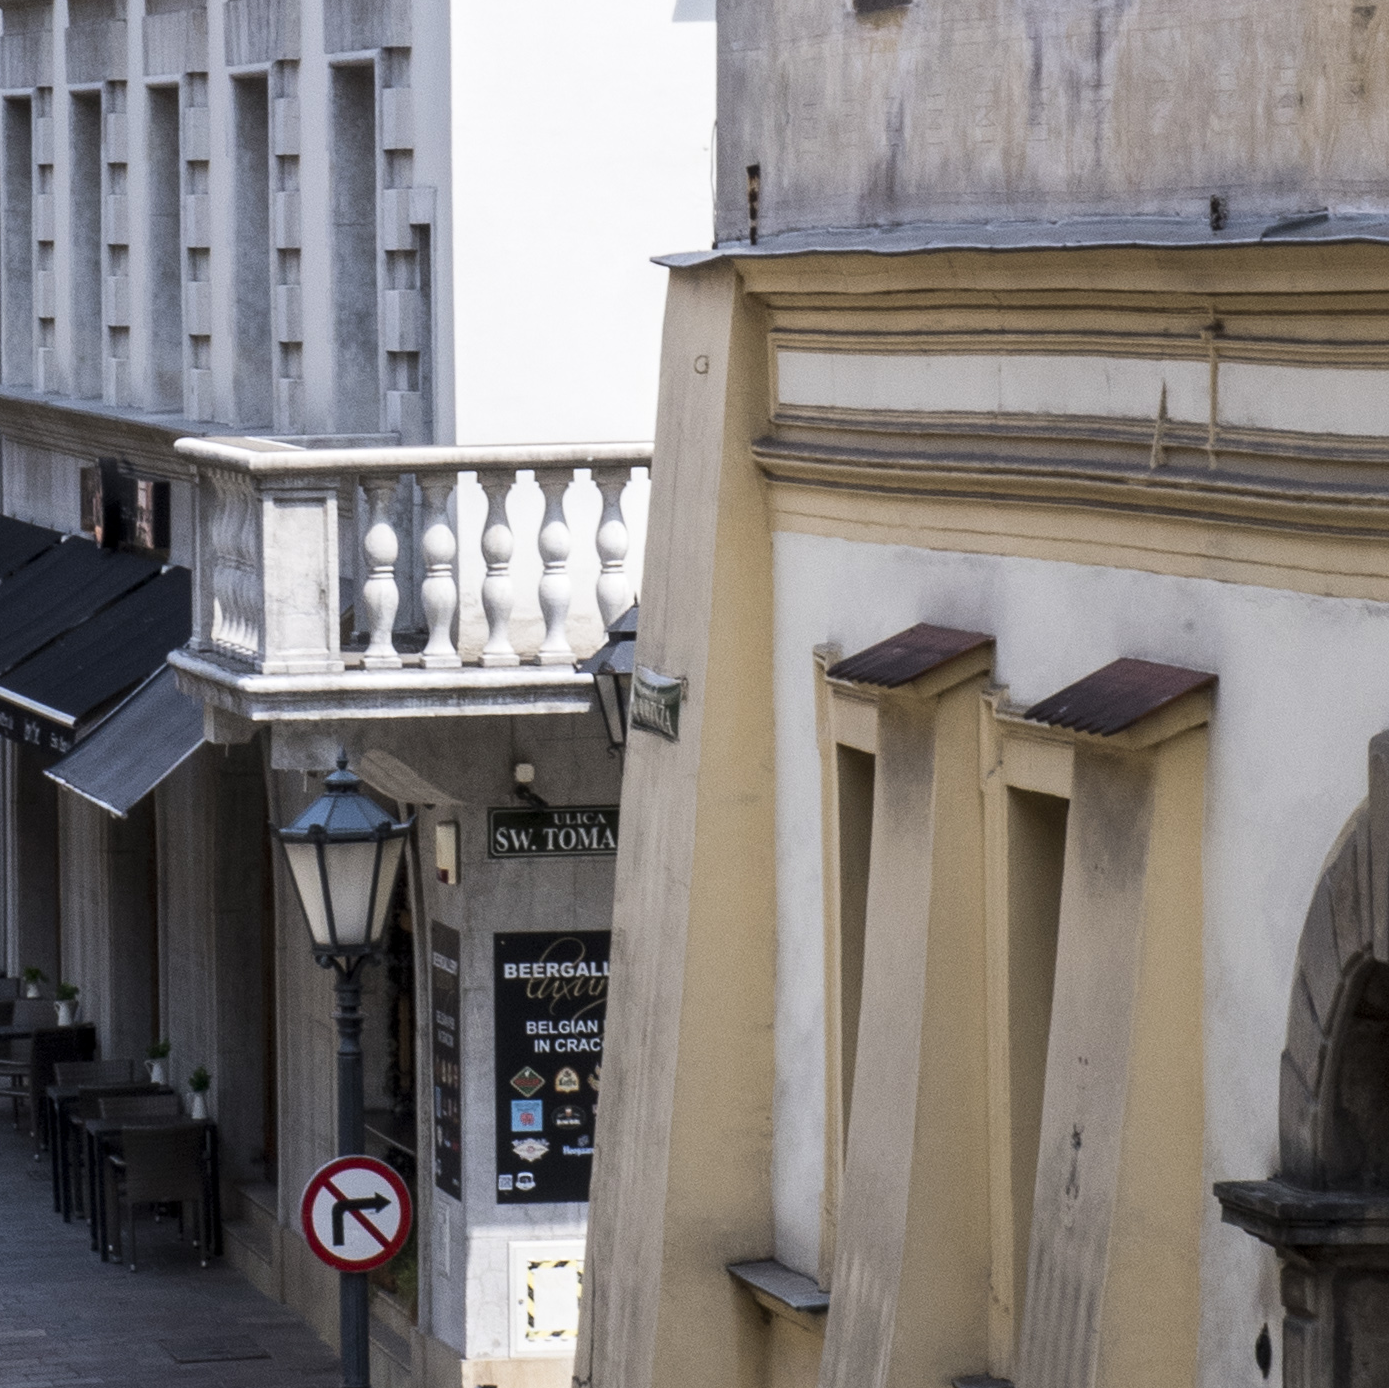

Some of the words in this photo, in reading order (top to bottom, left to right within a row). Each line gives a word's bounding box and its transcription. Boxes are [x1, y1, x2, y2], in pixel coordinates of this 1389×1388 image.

[554, 813, 606, 825] ULICA
[543, 827, 616, 850] TOMA
[526, 1019, 598, 1034] BELGIAN
[534, 1039, 550, 1053] IN
[555, 1038, 603, 1052] CRAC
